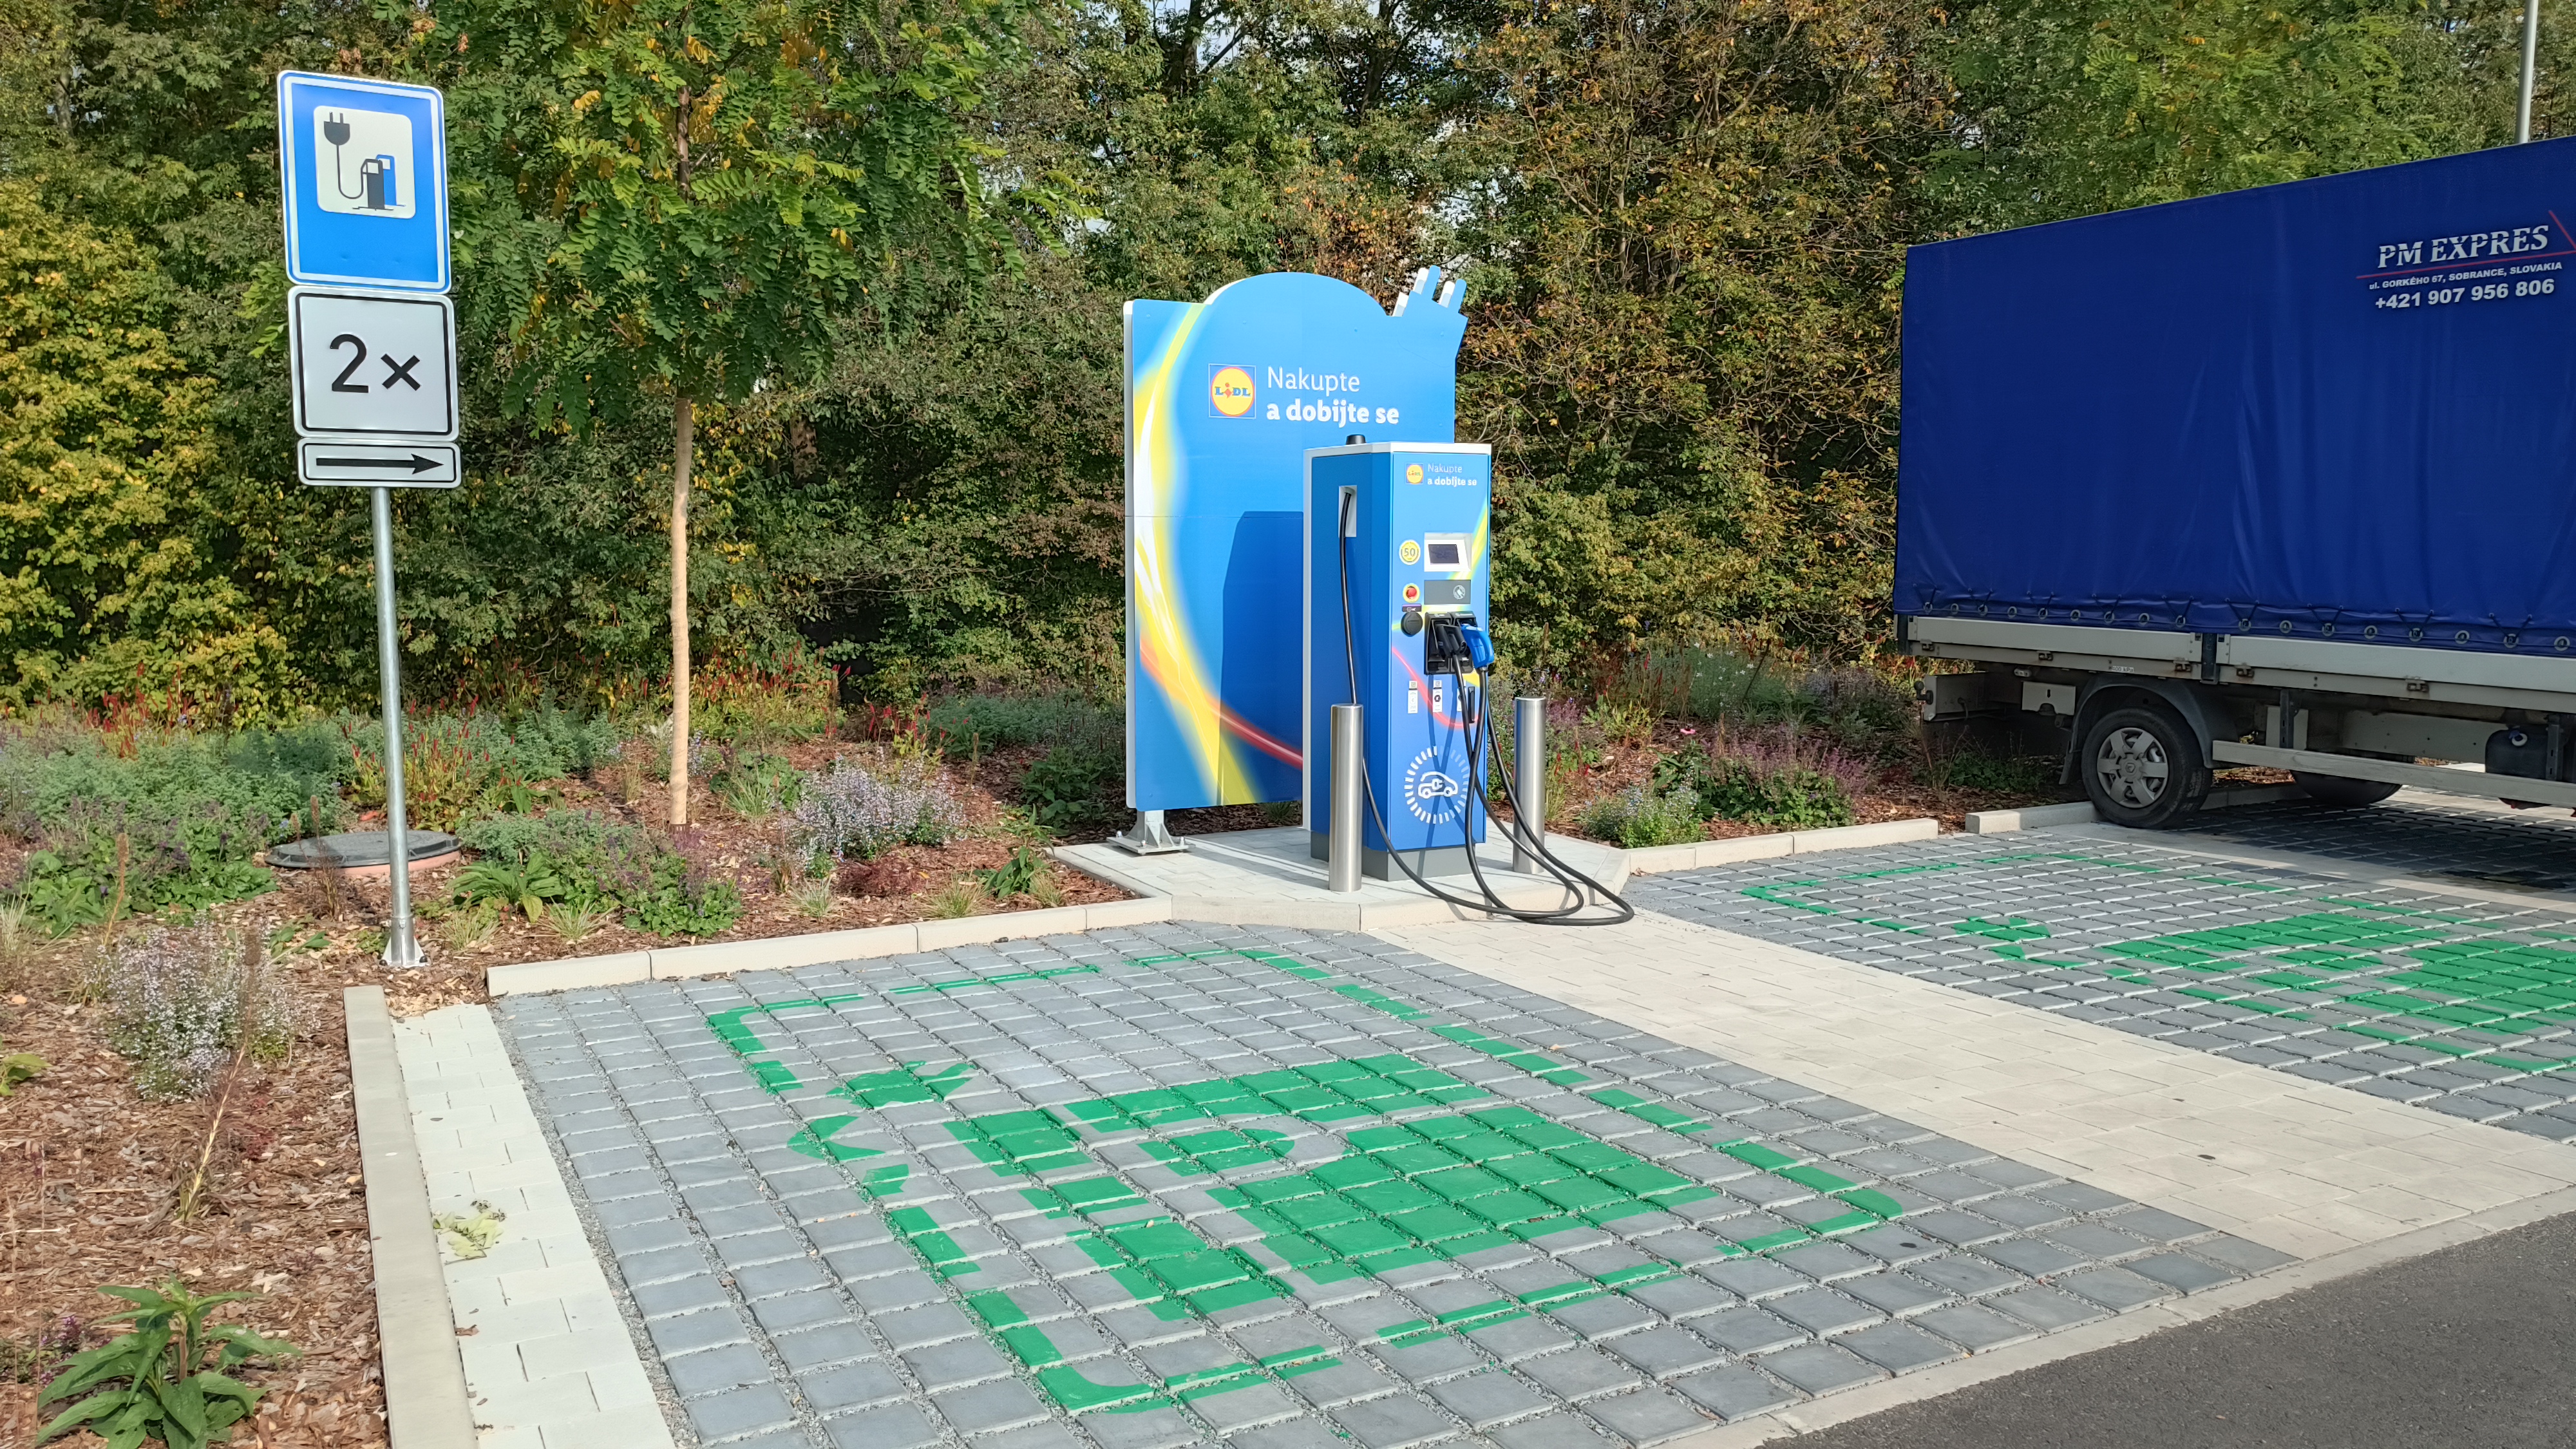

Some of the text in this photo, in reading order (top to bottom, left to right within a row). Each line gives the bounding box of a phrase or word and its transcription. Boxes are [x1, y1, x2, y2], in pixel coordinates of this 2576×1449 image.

[2378, 225, 2549, 269] PM EXPRES
[2382, 276, 2430, 289] GORKÉHO
[2432, 274, 2446, 283] 67,
[2448, 268, 2507, 281] SOBRANCE,
[2510, 261, 2562, 274] SLOVAKIA
[2375, 278, 2555, 309] +421 907 956 806
[1267, 365, 1360, 397] Nakupte
[1266, 397, 1400, 428] a dobijte se
[1427, 463, 1463, 475] Nakupte
[1434, 476, 1466, 488] dobijte
[1404, 548, 1416, 557] 50
